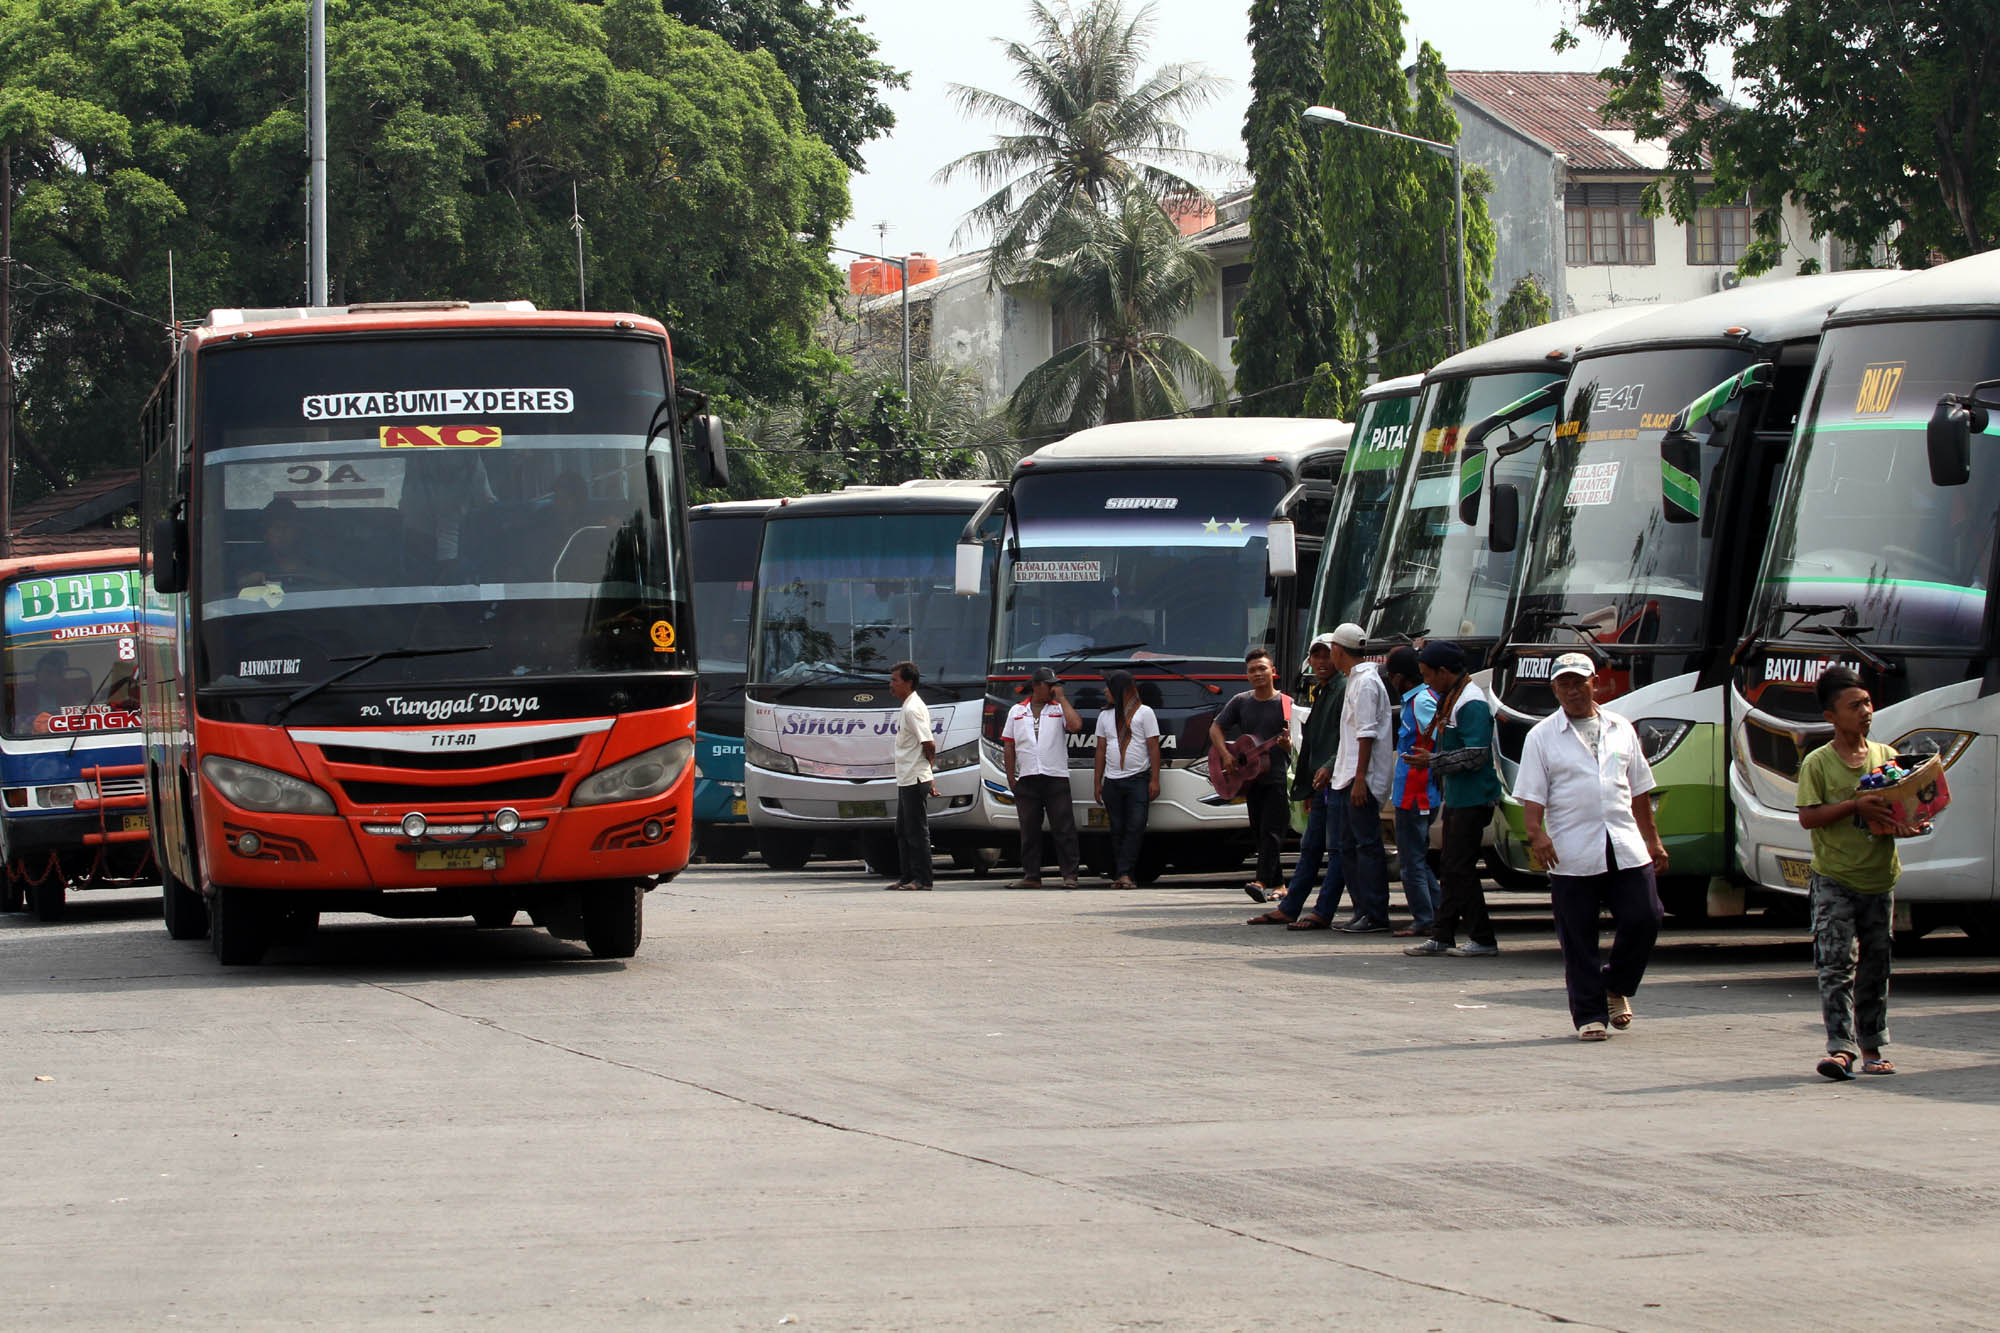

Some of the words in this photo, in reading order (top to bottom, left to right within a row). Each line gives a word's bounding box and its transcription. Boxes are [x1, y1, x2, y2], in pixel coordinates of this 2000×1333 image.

[306, 390, 570, 418] SUKABUMI-XDERES
[1592, 384, 1644, 413] E41
[383, 426, 499, 447] AC
[1104, 498, 1178, 509] SKIPPER
[119, 638, 136, 661] 8
[240, 660, 282, 677] BAYONET
[1516, 657, 1551, 678] MURNI
[1764, 658, 1801, 680] BAYU
[386, 692, 478, 720] Tunggal
[479, 694, 541, 718] Daya
[48, 709, 142, 733] CENGK
[782, 712, 866, 735] Sinar
[712, 745, 747, 757] garu
